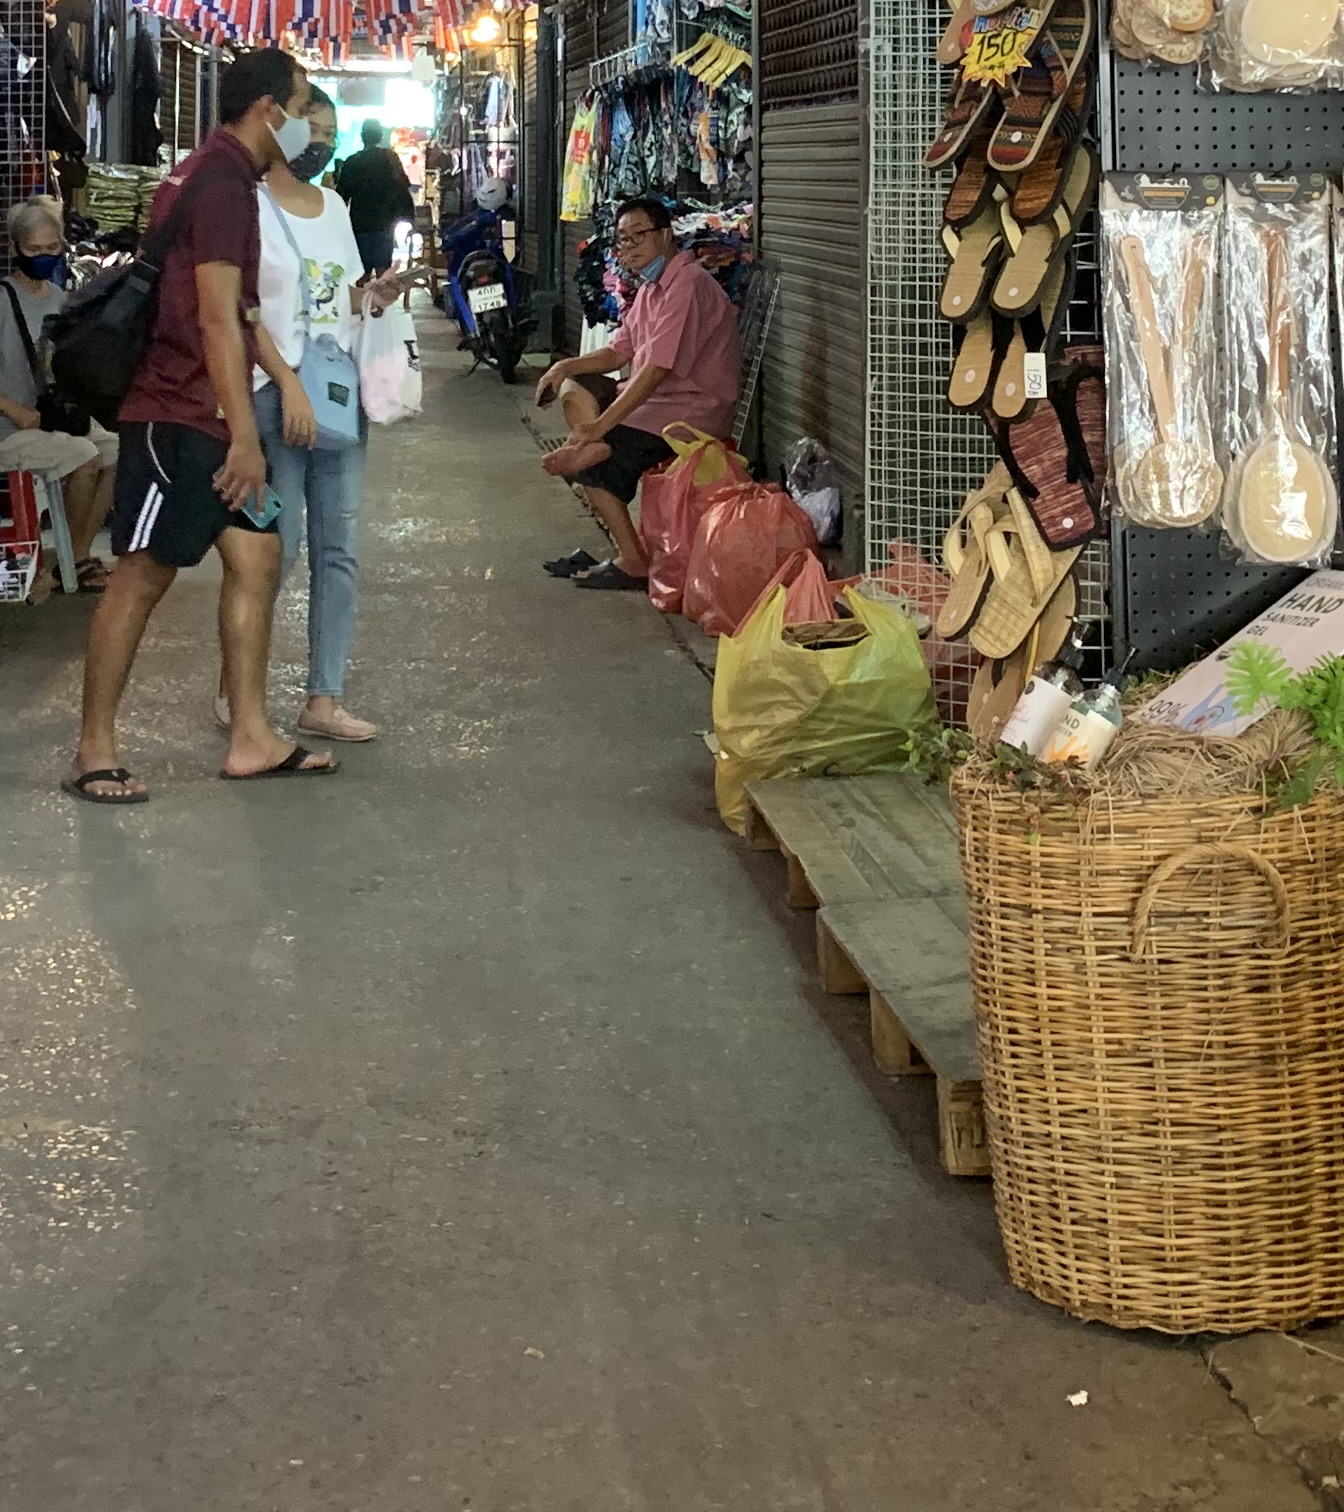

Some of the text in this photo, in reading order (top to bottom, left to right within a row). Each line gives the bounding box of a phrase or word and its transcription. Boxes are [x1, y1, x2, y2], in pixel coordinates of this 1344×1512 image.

[976, 29, 1017, 64] 150
[1279, 592, 1344, 615] HAND
[1262, 612, 1321, 628] SANITIZER
[1246, 625, 1268, 637] GEL
[1065, 713, 1081, 730] ND
[1141, 700, 1189, 723] 99%
